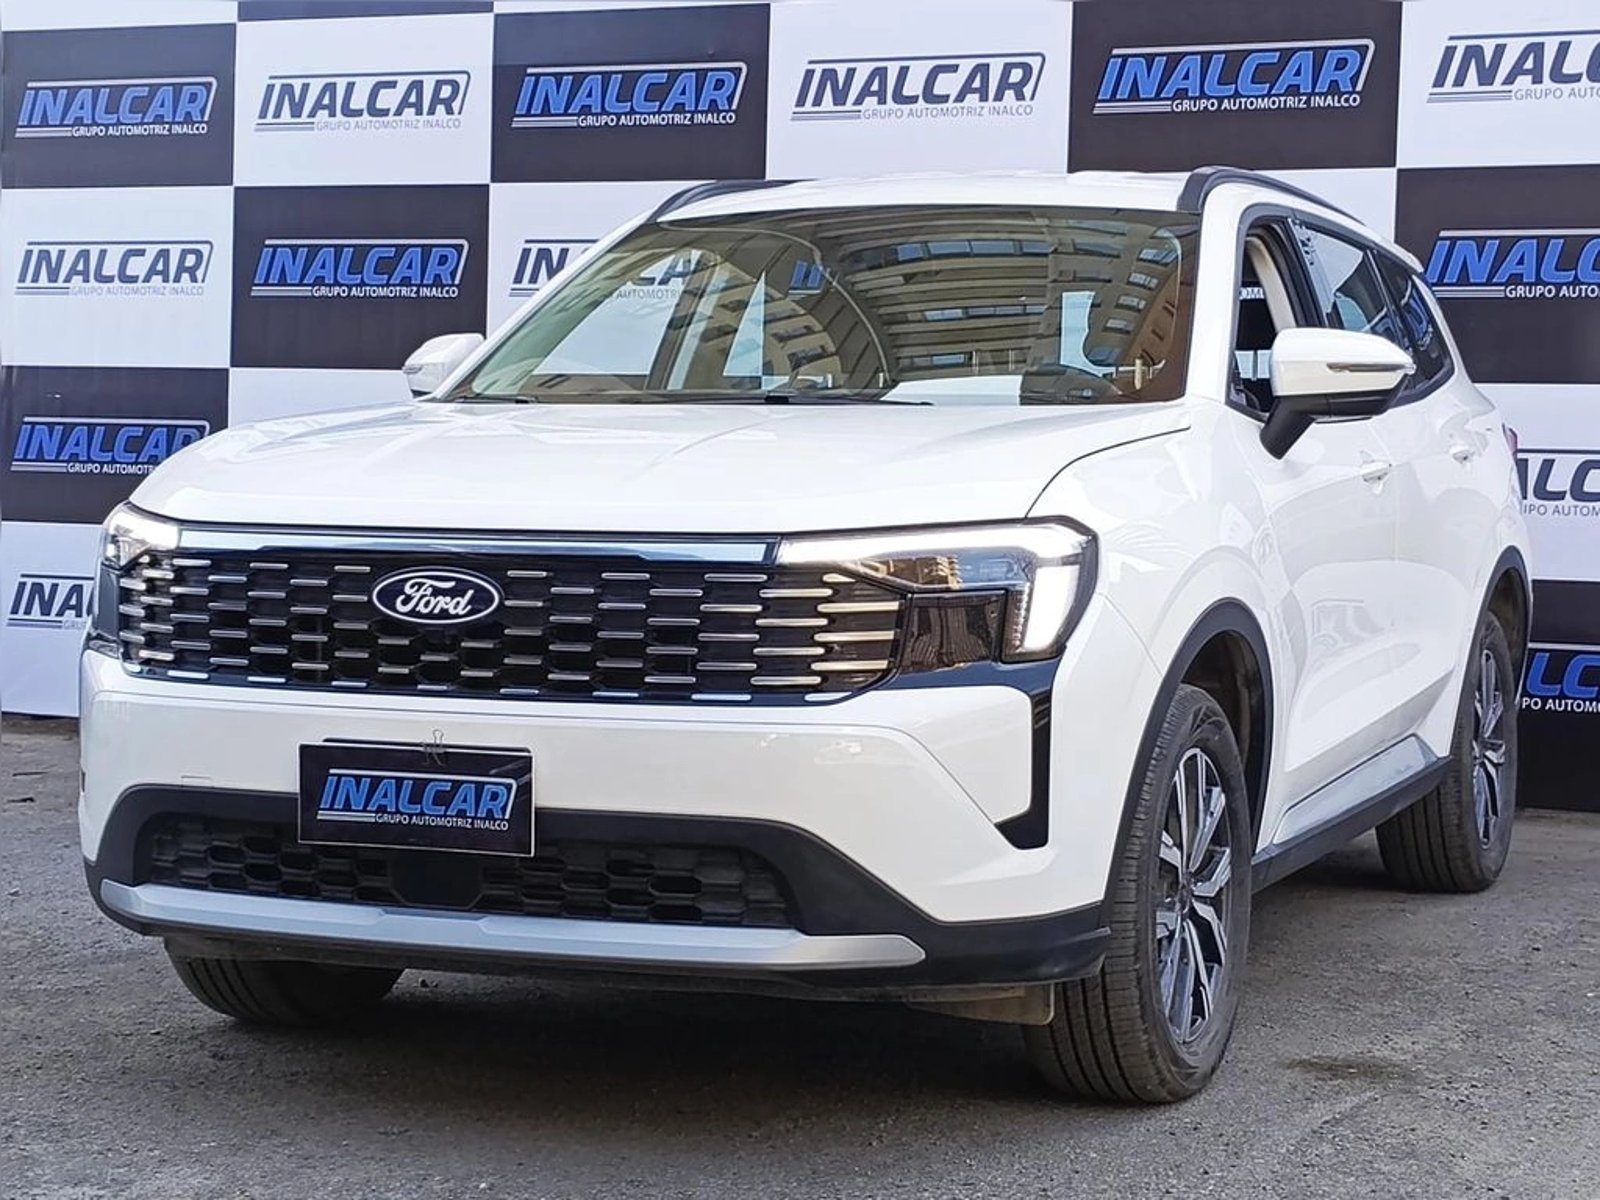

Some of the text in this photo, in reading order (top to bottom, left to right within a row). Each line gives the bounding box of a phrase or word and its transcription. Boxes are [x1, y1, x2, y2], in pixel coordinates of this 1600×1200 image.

[1097, 49, 1361, 100] INALCAR
[515, 71, 735, 114] INALCAR
[794, 62, 1033, 108] INALCAR
[1514, 87, 1563, 100] GRUPO
[18, 85, 207, 125] INALCAR
[258, 79, 461, 119] INALCAR
[1173, 94, 1361, 112] GRUPO AUTOMOTRIZ INALCO
[579, 112, 736, 126] GRUPO AUTOMOTRIZ INALCO
[863, 104, 1034, 119] GRUPO AUTOMOTRIZ INALCO
[72, 123, 207, 137] GRUPO AUTOMOTRIZ INALCO
[316, 117, 461, 131] GRUPO AUTOMOTRIZ INALCO
[17, 248, 204, 284] INALCAR
[254, 247, 459, 285] INALCAR
[312, 286, 459, 298] GRUPO AUTOMOTRIZ INALCO
[1506, 285, 1555, 298] GRUPO
[67, 462, 100, 473] GRUPO
[395, 578, 474, 615] Ford
[1545, 699, 1600, 713] AUTOM
[320, 776, 508, 818] INALCAR
[375, 813, 509, 831] GRUPO AUTOMOTRIZ INALCO
